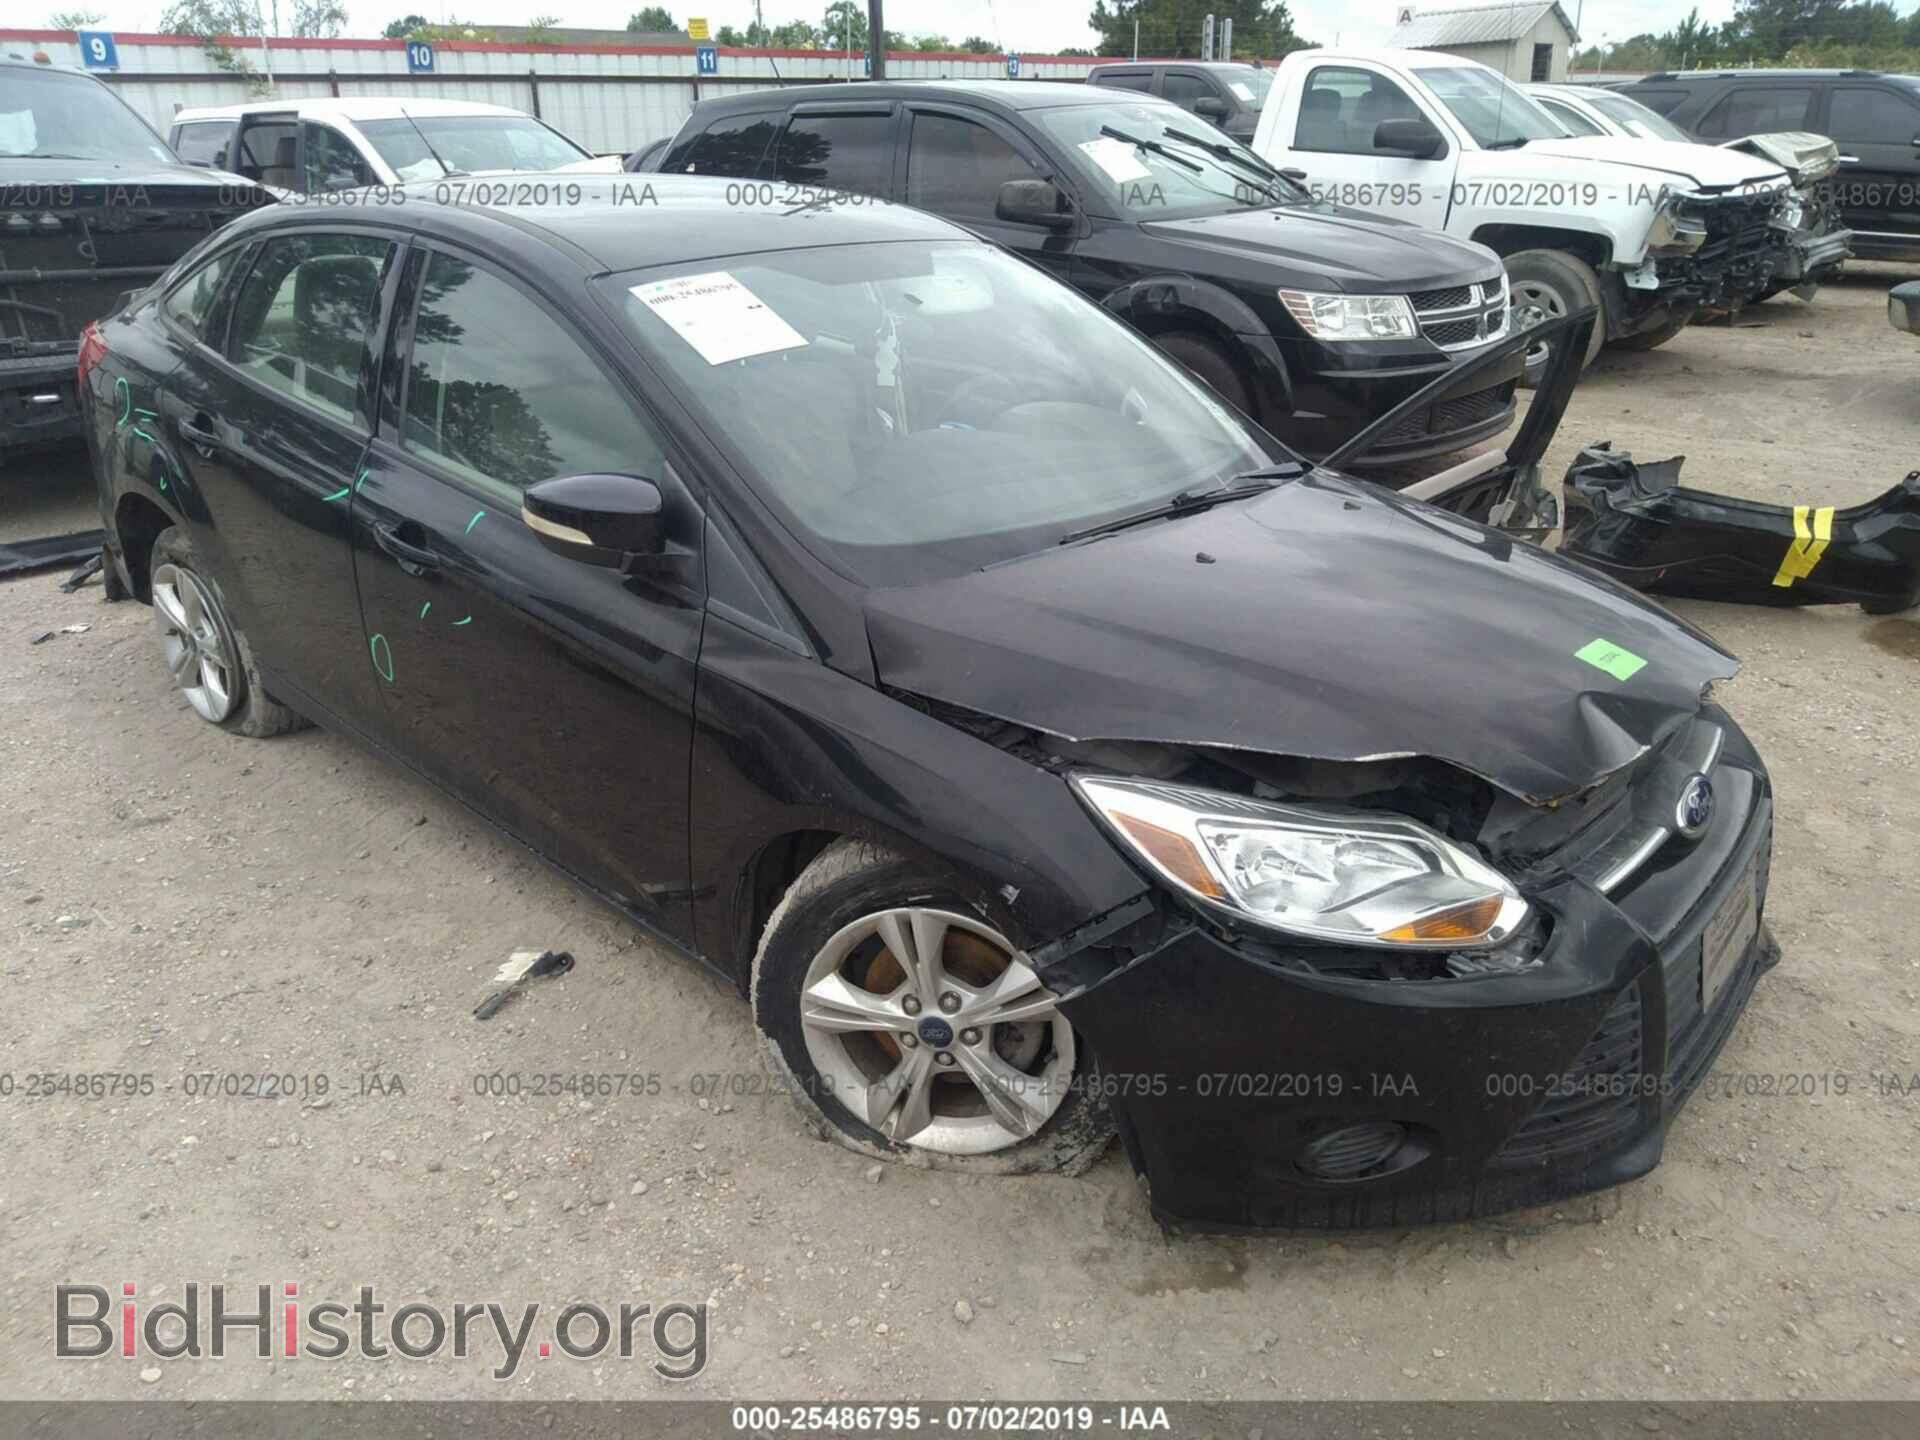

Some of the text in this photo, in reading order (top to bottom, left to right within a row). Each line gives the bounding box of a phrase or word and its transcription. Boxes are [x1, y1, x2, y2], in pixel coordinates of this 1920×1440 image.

[1400, 9, 1411, 23] A
[91, 38, 106, 61] 9
[411, 46, 430, 66] 10
[701, 51, 714, 69] 11
